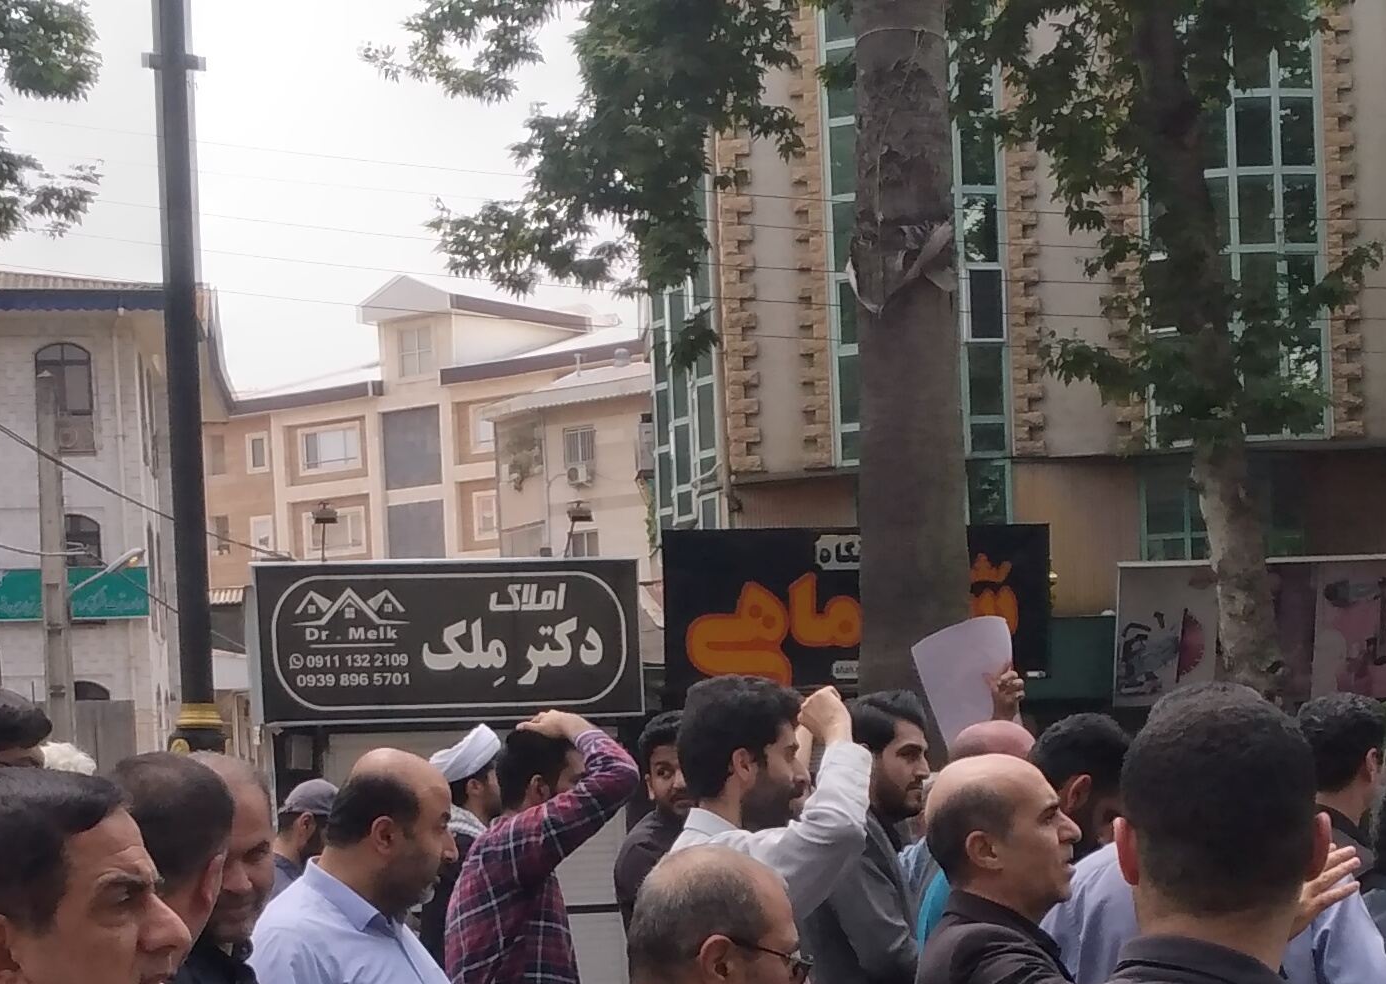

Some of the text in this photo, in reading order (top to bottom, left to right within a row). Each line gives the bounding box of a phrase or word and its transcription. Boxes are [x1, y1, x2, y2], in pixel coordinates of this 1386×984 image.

[488, 582, 567, 612] املاک
[348, 627, 398, 640] Melk
[517, 616, 603, 685] دکتر
[306, 653, 409, 668] 0911 132 2109
[296, 672, 410, 687] 0939 896 5701
